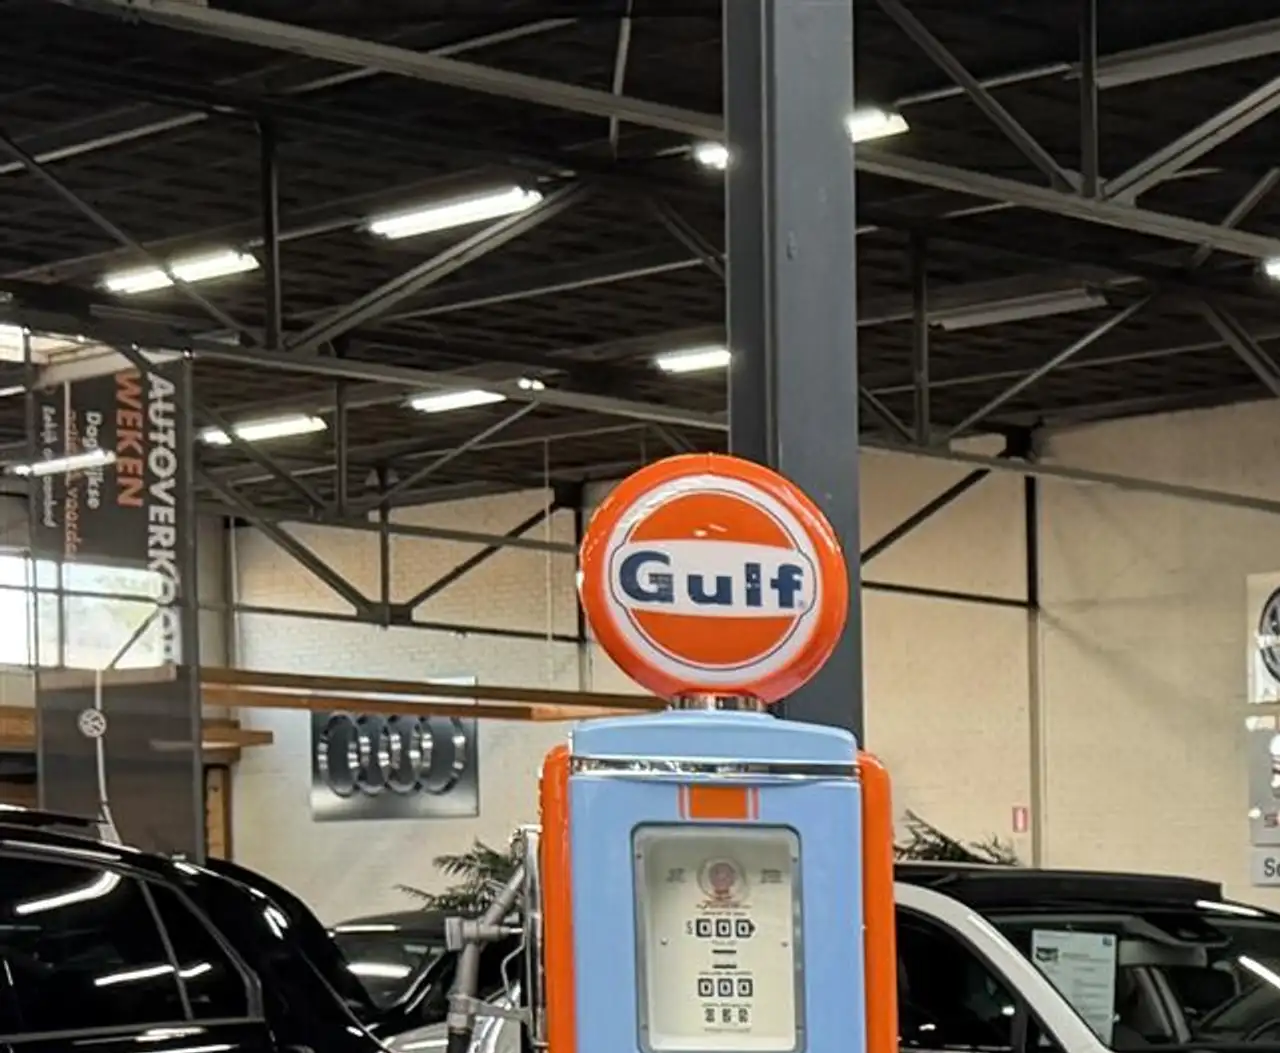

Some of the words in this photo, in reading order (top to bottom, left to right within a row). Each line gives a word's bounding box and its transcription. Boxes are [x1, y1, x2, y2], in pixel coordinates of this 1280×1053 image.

[83, 411, 104, 509] Dagijkse
[116, 372, 143, 508] WEKEN
[618, 550, 805, 609] Gulf
